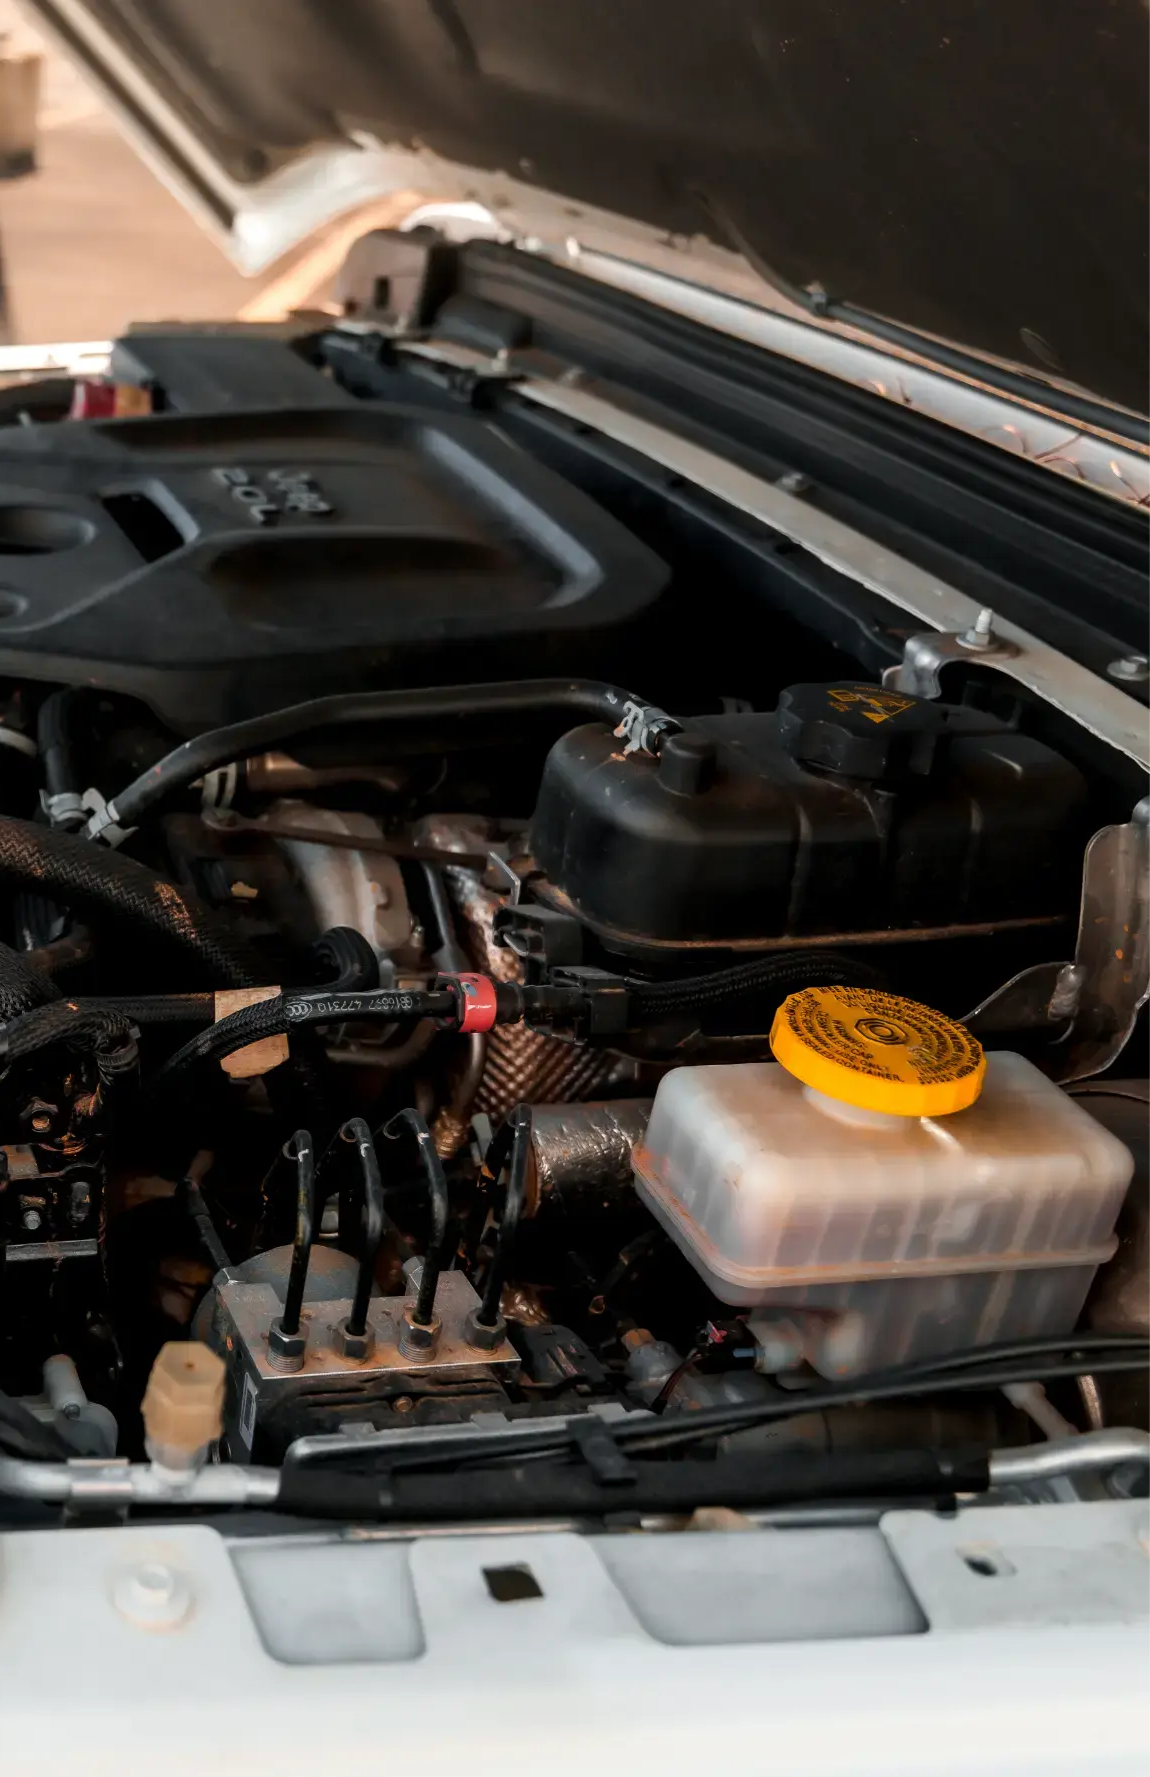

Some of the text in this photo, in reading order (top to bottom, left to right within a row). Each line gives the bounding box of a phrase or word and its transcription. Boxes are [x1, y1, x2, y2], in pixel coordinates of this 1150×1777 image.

[800, 1038, 837, 1060] SEALED
[834, 1059, 906, 1083] CONTAINER.
[834, 1050, 859, 1063] USE
[849, 1049, 875, 1061] CAP
